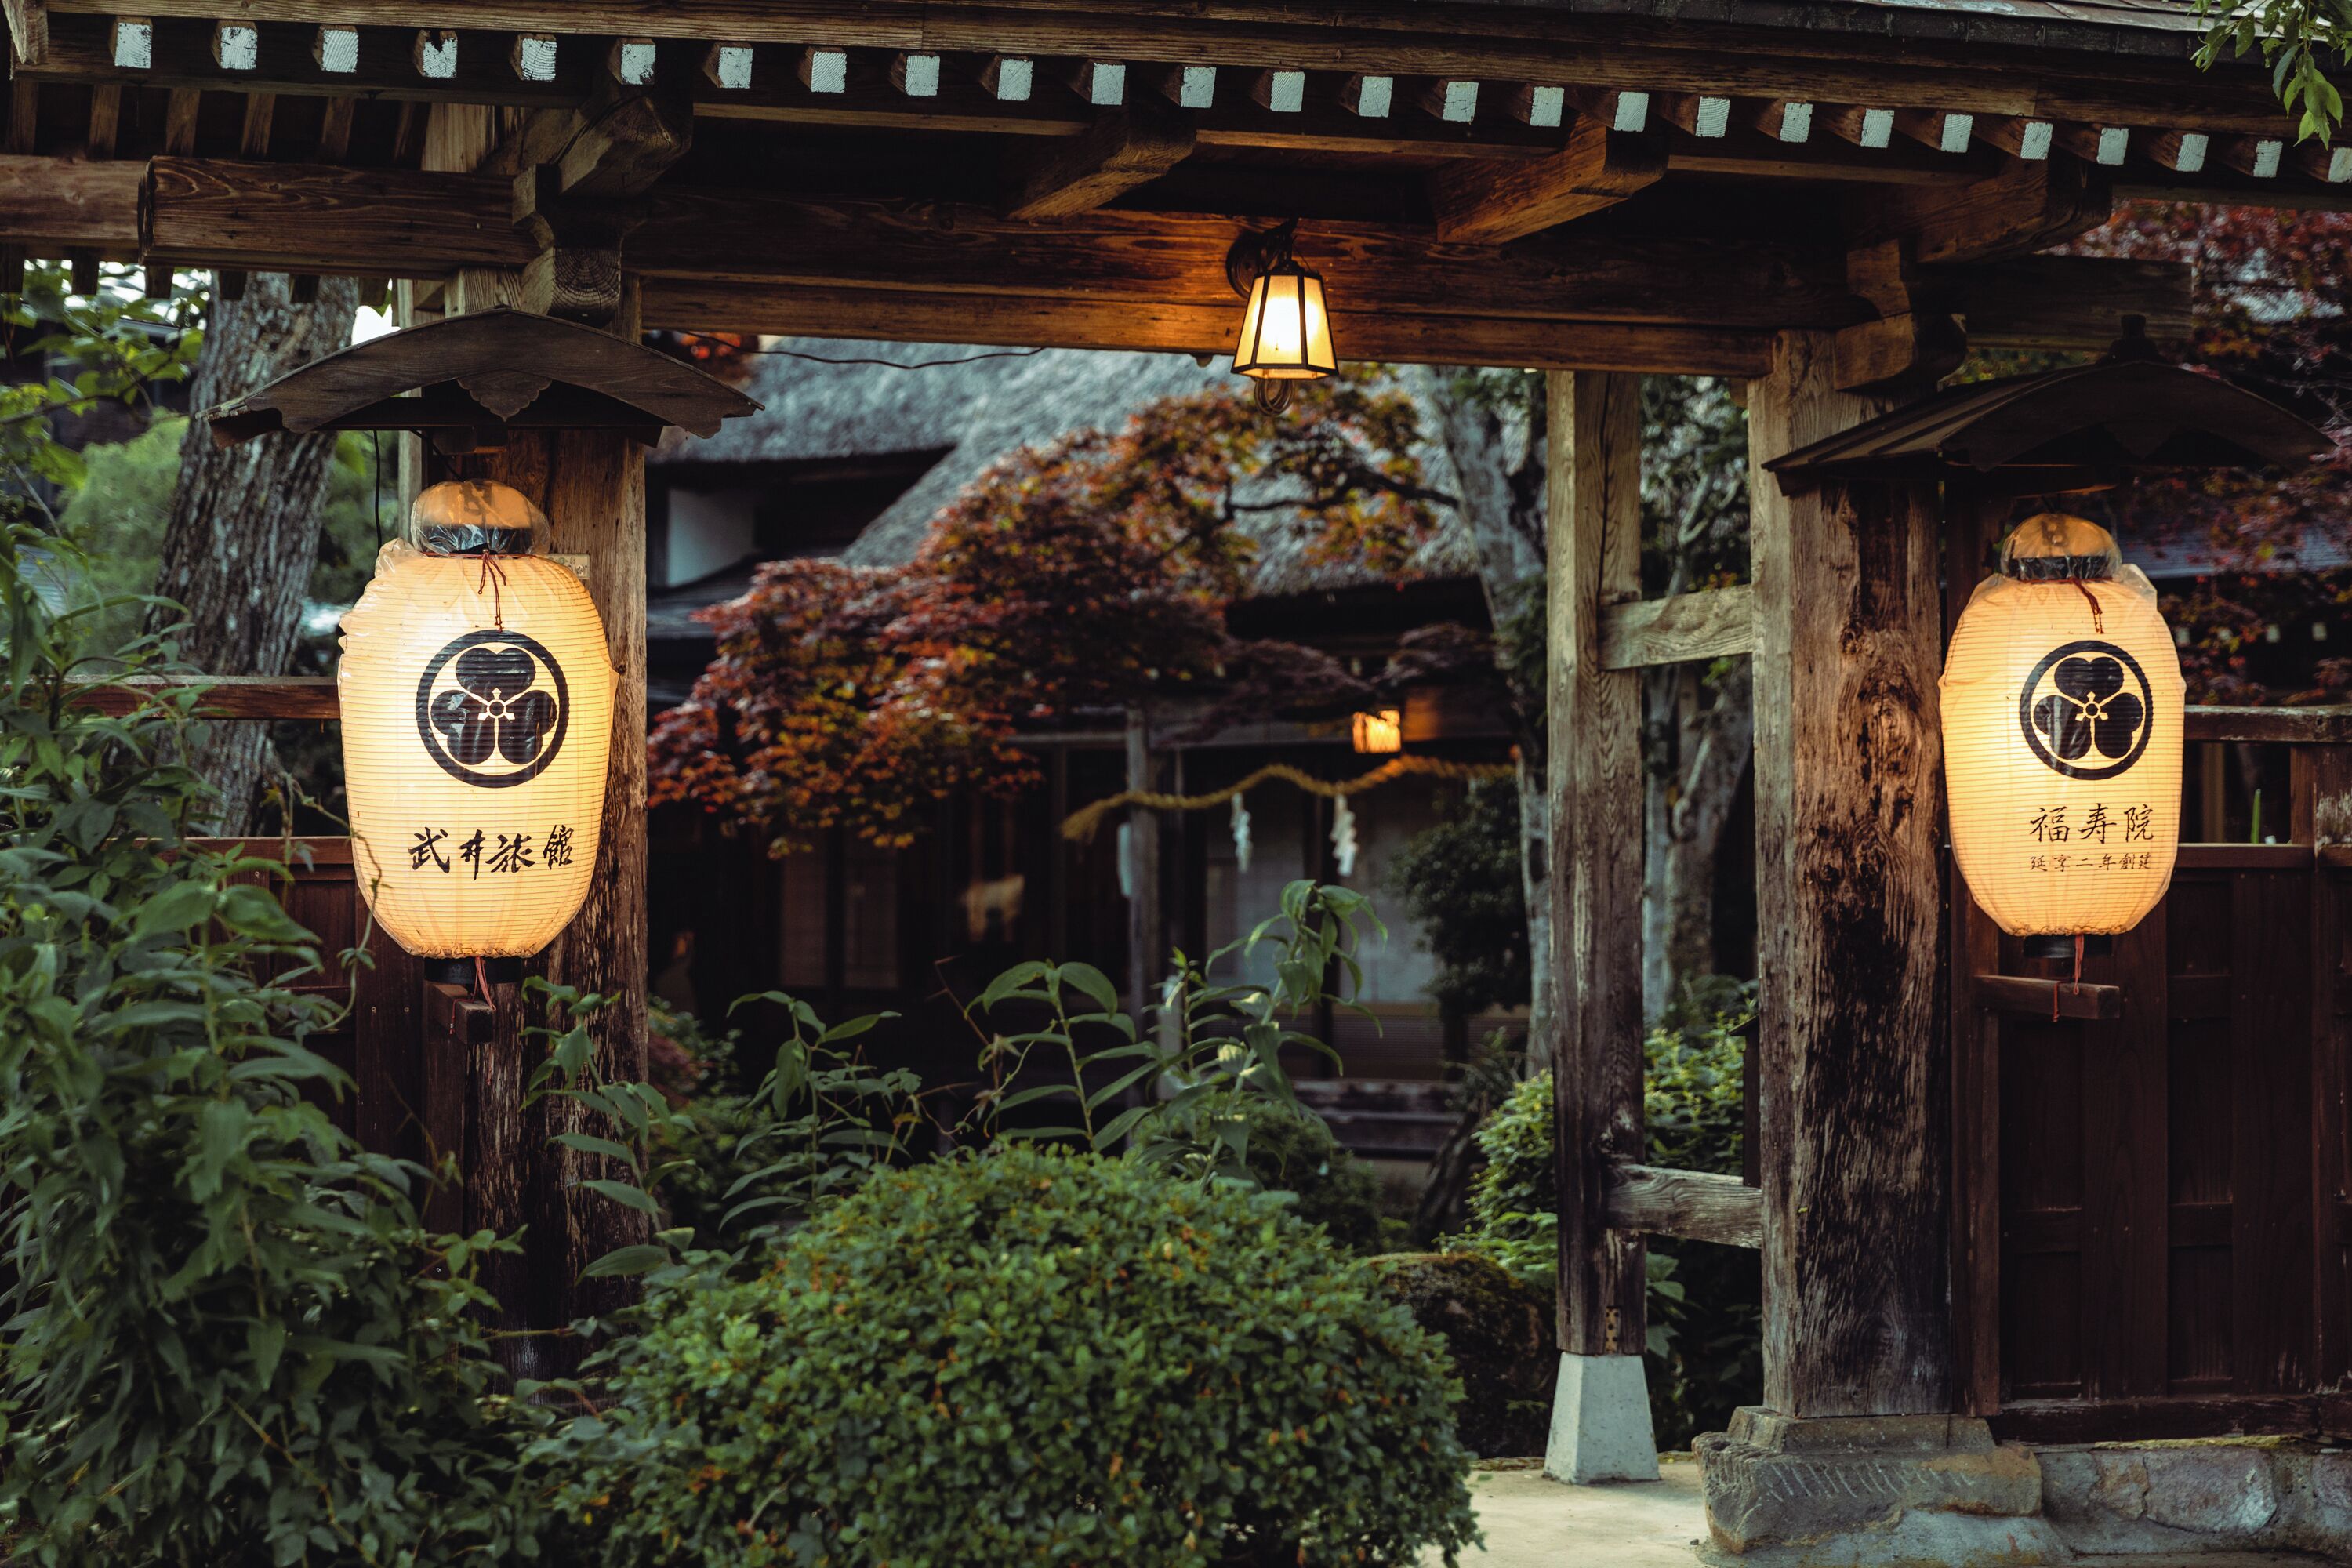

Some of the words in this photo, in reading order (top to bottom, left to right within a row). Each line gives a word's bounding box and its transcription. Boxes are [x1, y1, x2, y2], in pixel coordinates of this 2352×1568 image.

[2029, 803, 2154, 844] 福寿院
[408, 825, 574, 880] 武井旅館
